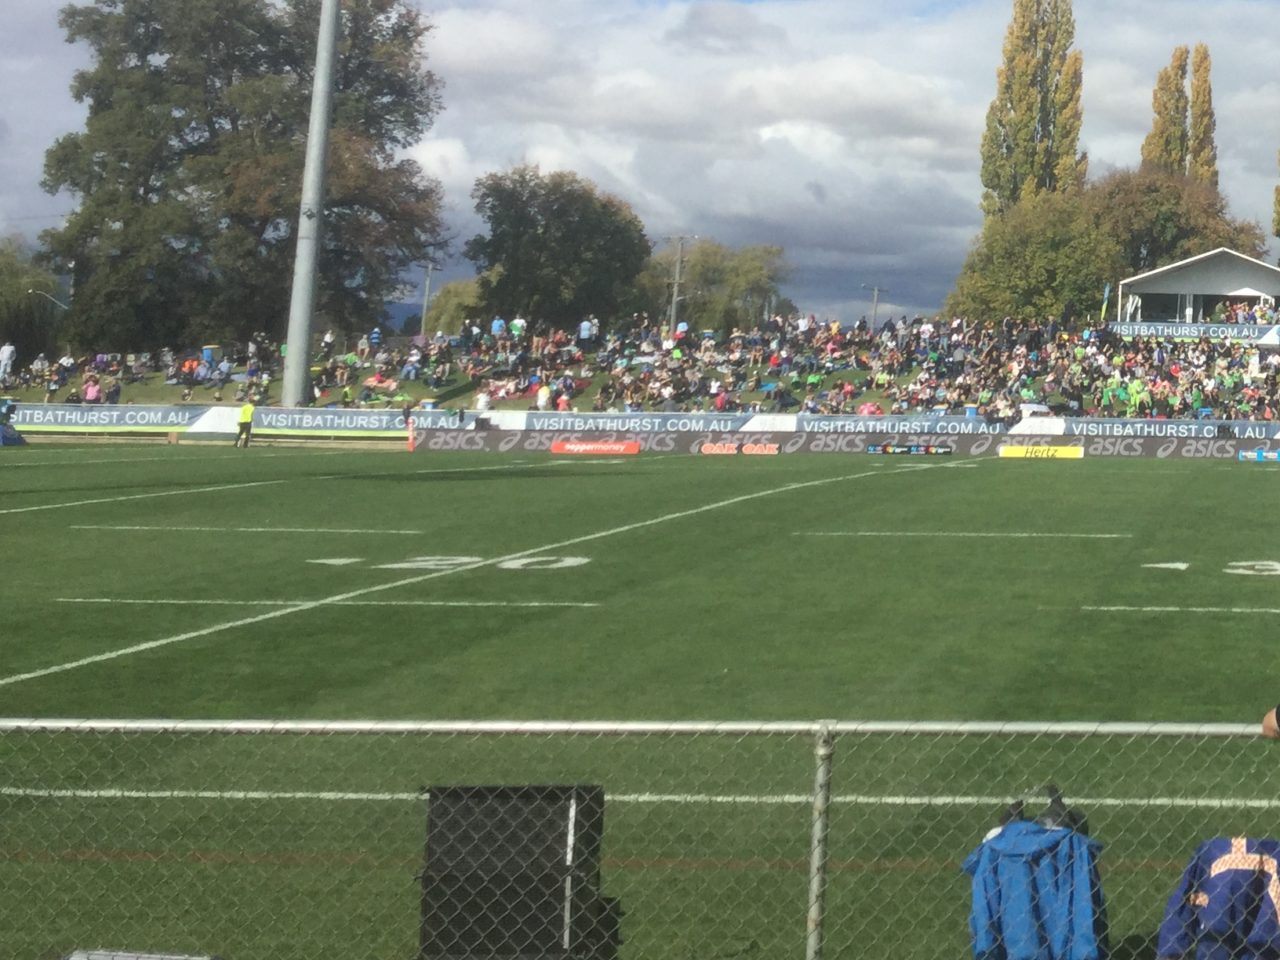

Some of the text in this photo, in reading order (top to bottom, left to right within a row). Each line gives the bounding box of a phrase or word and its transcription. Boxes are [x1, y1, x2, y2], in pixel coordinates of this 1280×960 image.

[1111, 324, 1258, 337] VISITBATHURST.COM.AU
[10, 409, 189, 424] SITBATHURST.COM.AU
[533, 417, 731, 431] VISITBATHURST.COM.AU
[803, 421, 1000, 434] VISITBATHURST.COM.AU
[1072, 423, 1266, 439] VISITBATHURST.CM.AU
[701, 443, 779, 454] OAK OAK
[1024, 447, 1058, 458] Hertz
